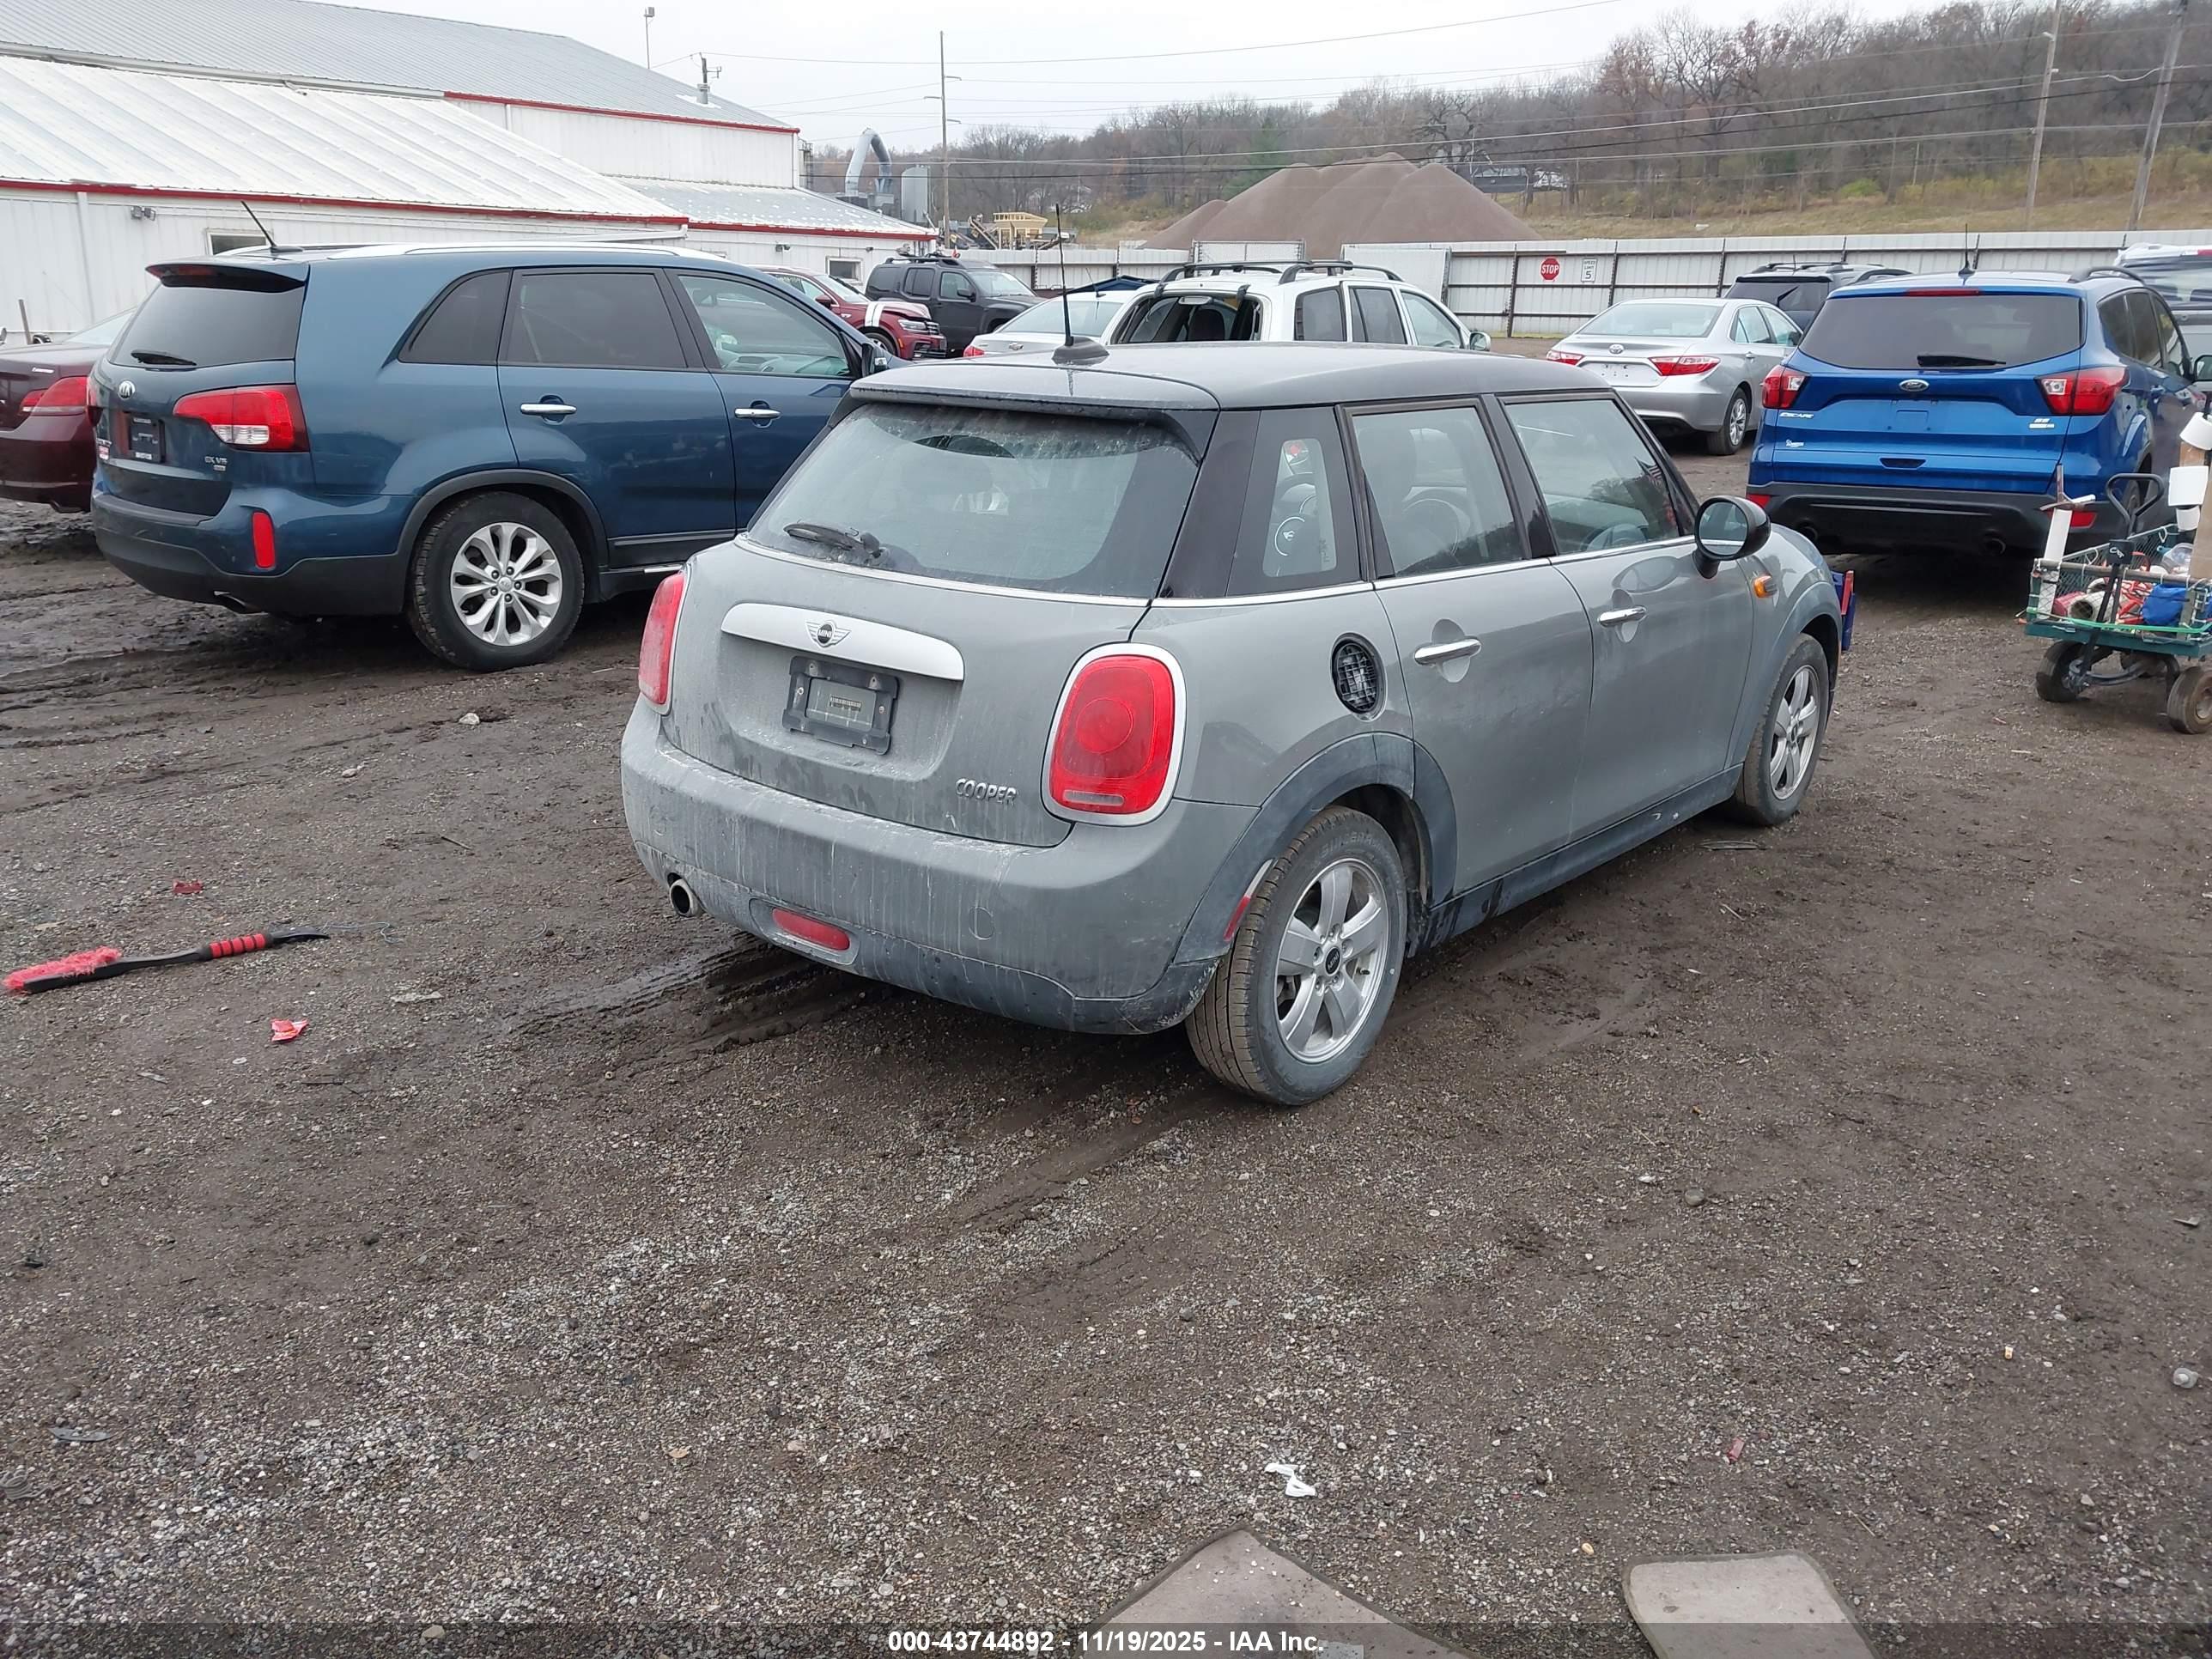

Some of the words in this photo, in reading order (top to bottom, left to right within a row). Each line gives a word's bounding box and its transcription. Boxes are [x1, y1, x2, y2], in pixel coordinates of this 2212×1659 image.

[1541, 264, 1559, 275] STOP
[1585, 270, 1592, 279] 5
[817, 629, 832, 638] MINI
[956, 778, 1018, 805] COOPER
